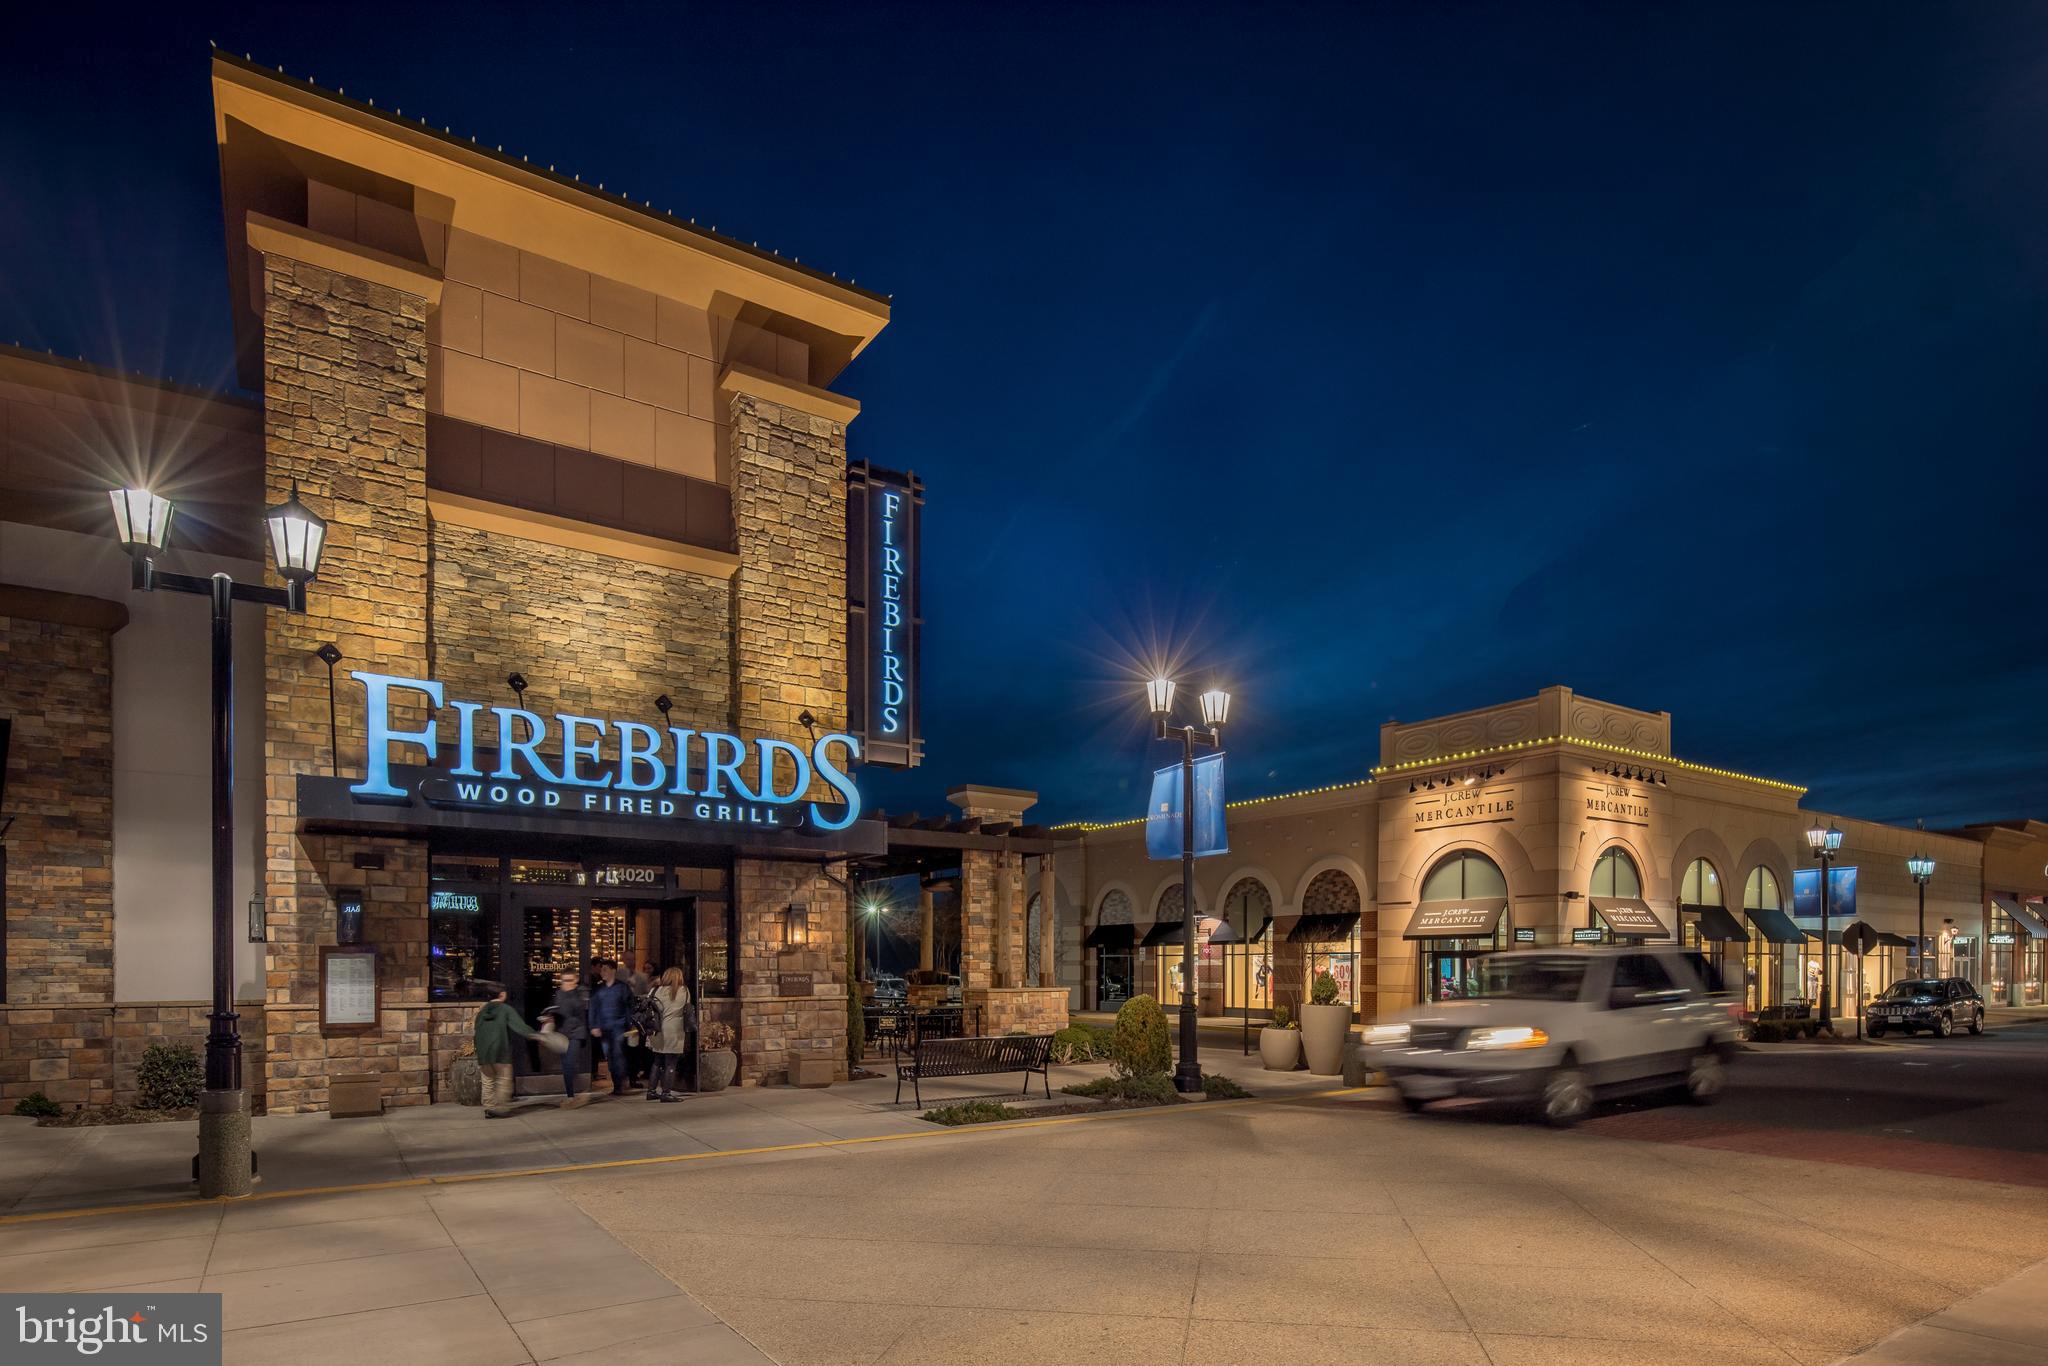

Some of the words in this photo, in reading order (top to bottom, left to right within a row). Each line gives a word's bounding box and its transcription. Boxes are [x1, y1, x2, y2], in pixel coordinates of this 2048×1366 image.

[883, 492, 904, 733] FIREBIRDS
[350, 670, 861, 830] FIREBIRDS
[457, 783, 561, 806] WOOD
[584, 793, 675, 816] FIRED
[696, 803, 779, 824] GRILL
[1443, 788, 1481, 806] J.CREW
[1586, 798, 1649, 817] MERCANTILE
[1415, 800, 1514, 822] MERCANTILE
[618, 868, 655, 883] 4020
